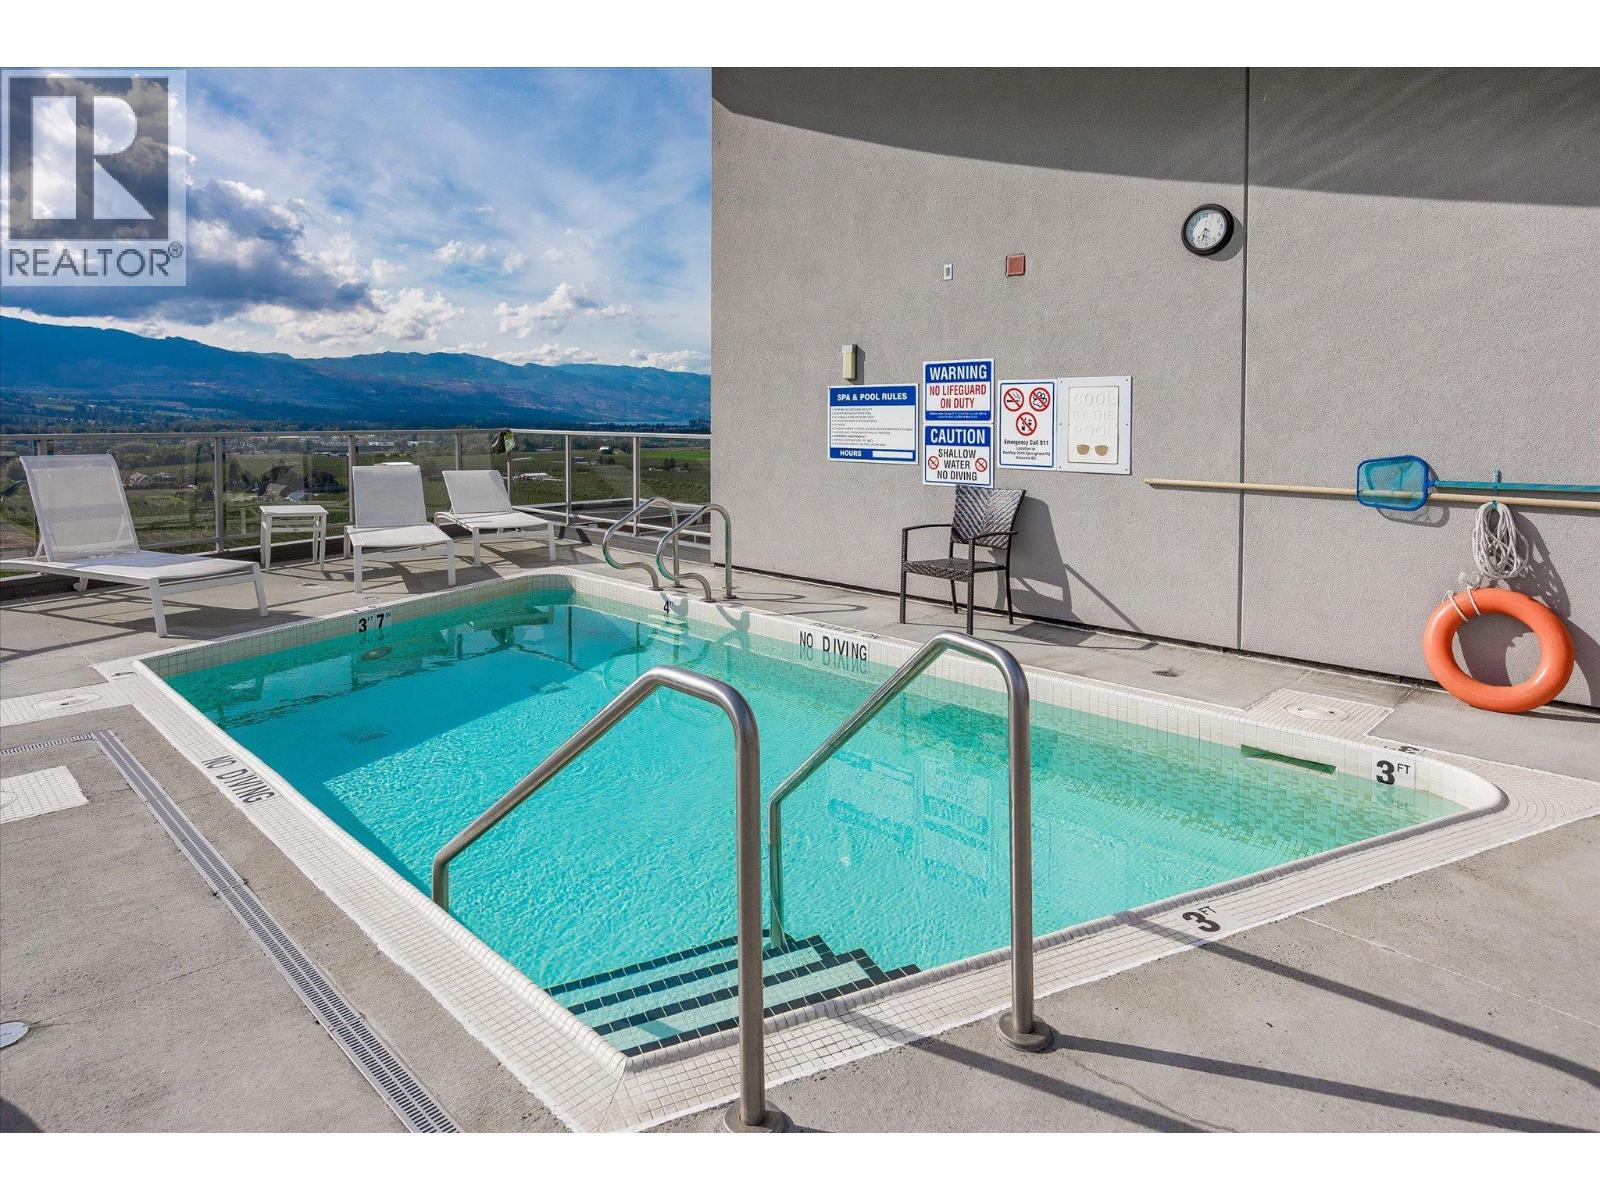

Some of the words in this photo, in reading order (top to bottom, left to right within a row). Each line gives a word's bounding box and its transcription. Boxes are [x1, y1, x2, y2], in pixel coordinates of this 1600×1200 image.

[929, 364, 987, 380] WARNING
[837, 393, 850, 401] SPA
[852, 393, 858, 401] &
[860, 393, 880, 401] POOL
[881, 392, 907, 400] RULES
[929, 385, 940, 396] NO
[942, 384, 986, 395] LIFEGUARD
[940, 398, 951, 408] ON
[953, 397, 975, 408] DUTY
[1073, 391, 1116, 406] COOL
[1091, 410, 1114, 420] THE
[930, 428, 985, 444] CAUTION
[938, 448, 977, 459] SHALLOW
[943, 459, 970, 469] WATER
[937, 470, 948, 479] NO
[950, 471, 977, 481] DIVING
[663, 600, 670, 614] 4
[358, 618, 367, 632] 3
[376, 613, 385, 628] 7
[799, 630, 814, 648] NO
[822, 635, 867, 661] DIVING
[200, 754, 237, 769] NO
[1376, 760, 1396, 785] 3
[1397, 763, 1411, 775] FT
[216, 768, 275, 803] DIVING
[1198, 905, 1217, 916] FT
[1182, 911, 1221, 932] 3
